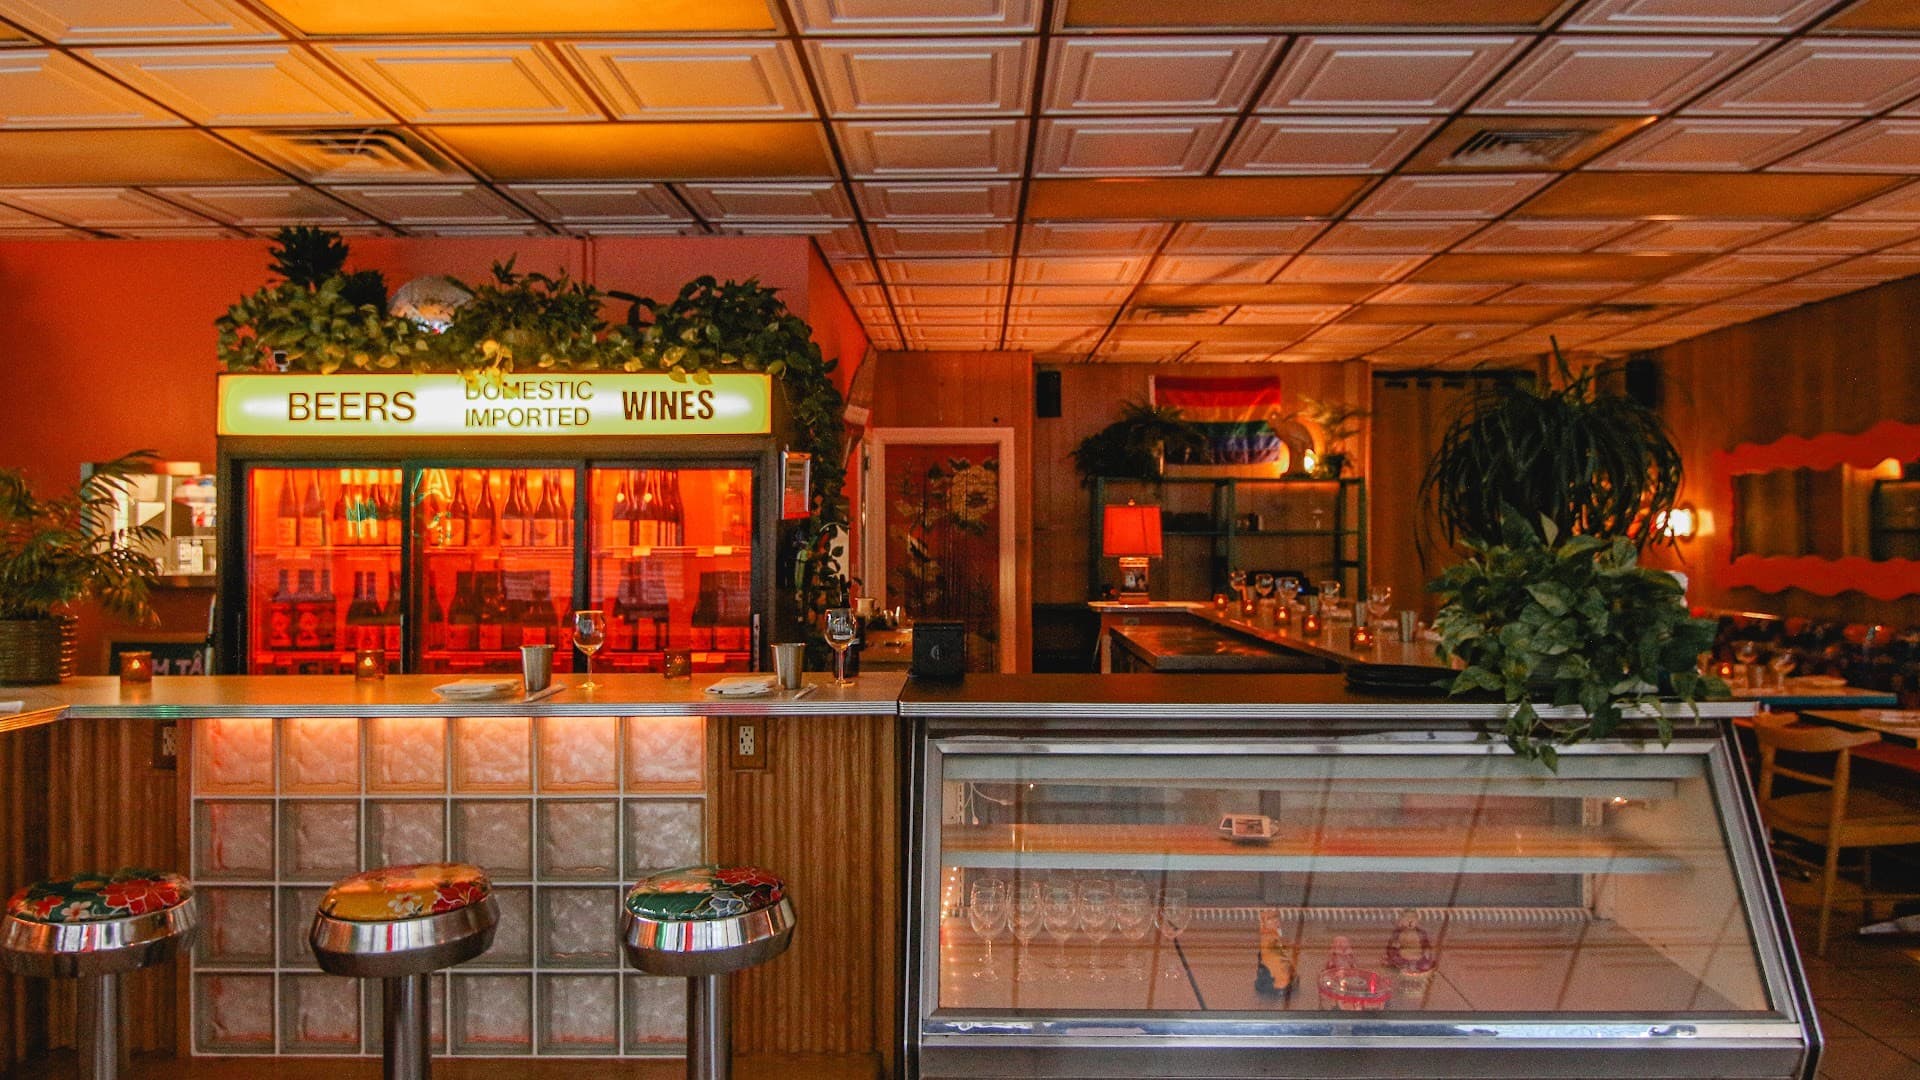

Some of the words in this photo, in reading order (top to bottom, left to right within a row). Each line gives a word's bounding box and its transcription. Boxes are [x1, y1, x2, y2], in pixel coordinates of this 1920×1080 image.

[288, 391, 416, 421] BEERS
[465, 407, 590, 427] IMPORTED
[622, 390, 715, 420] WINES
